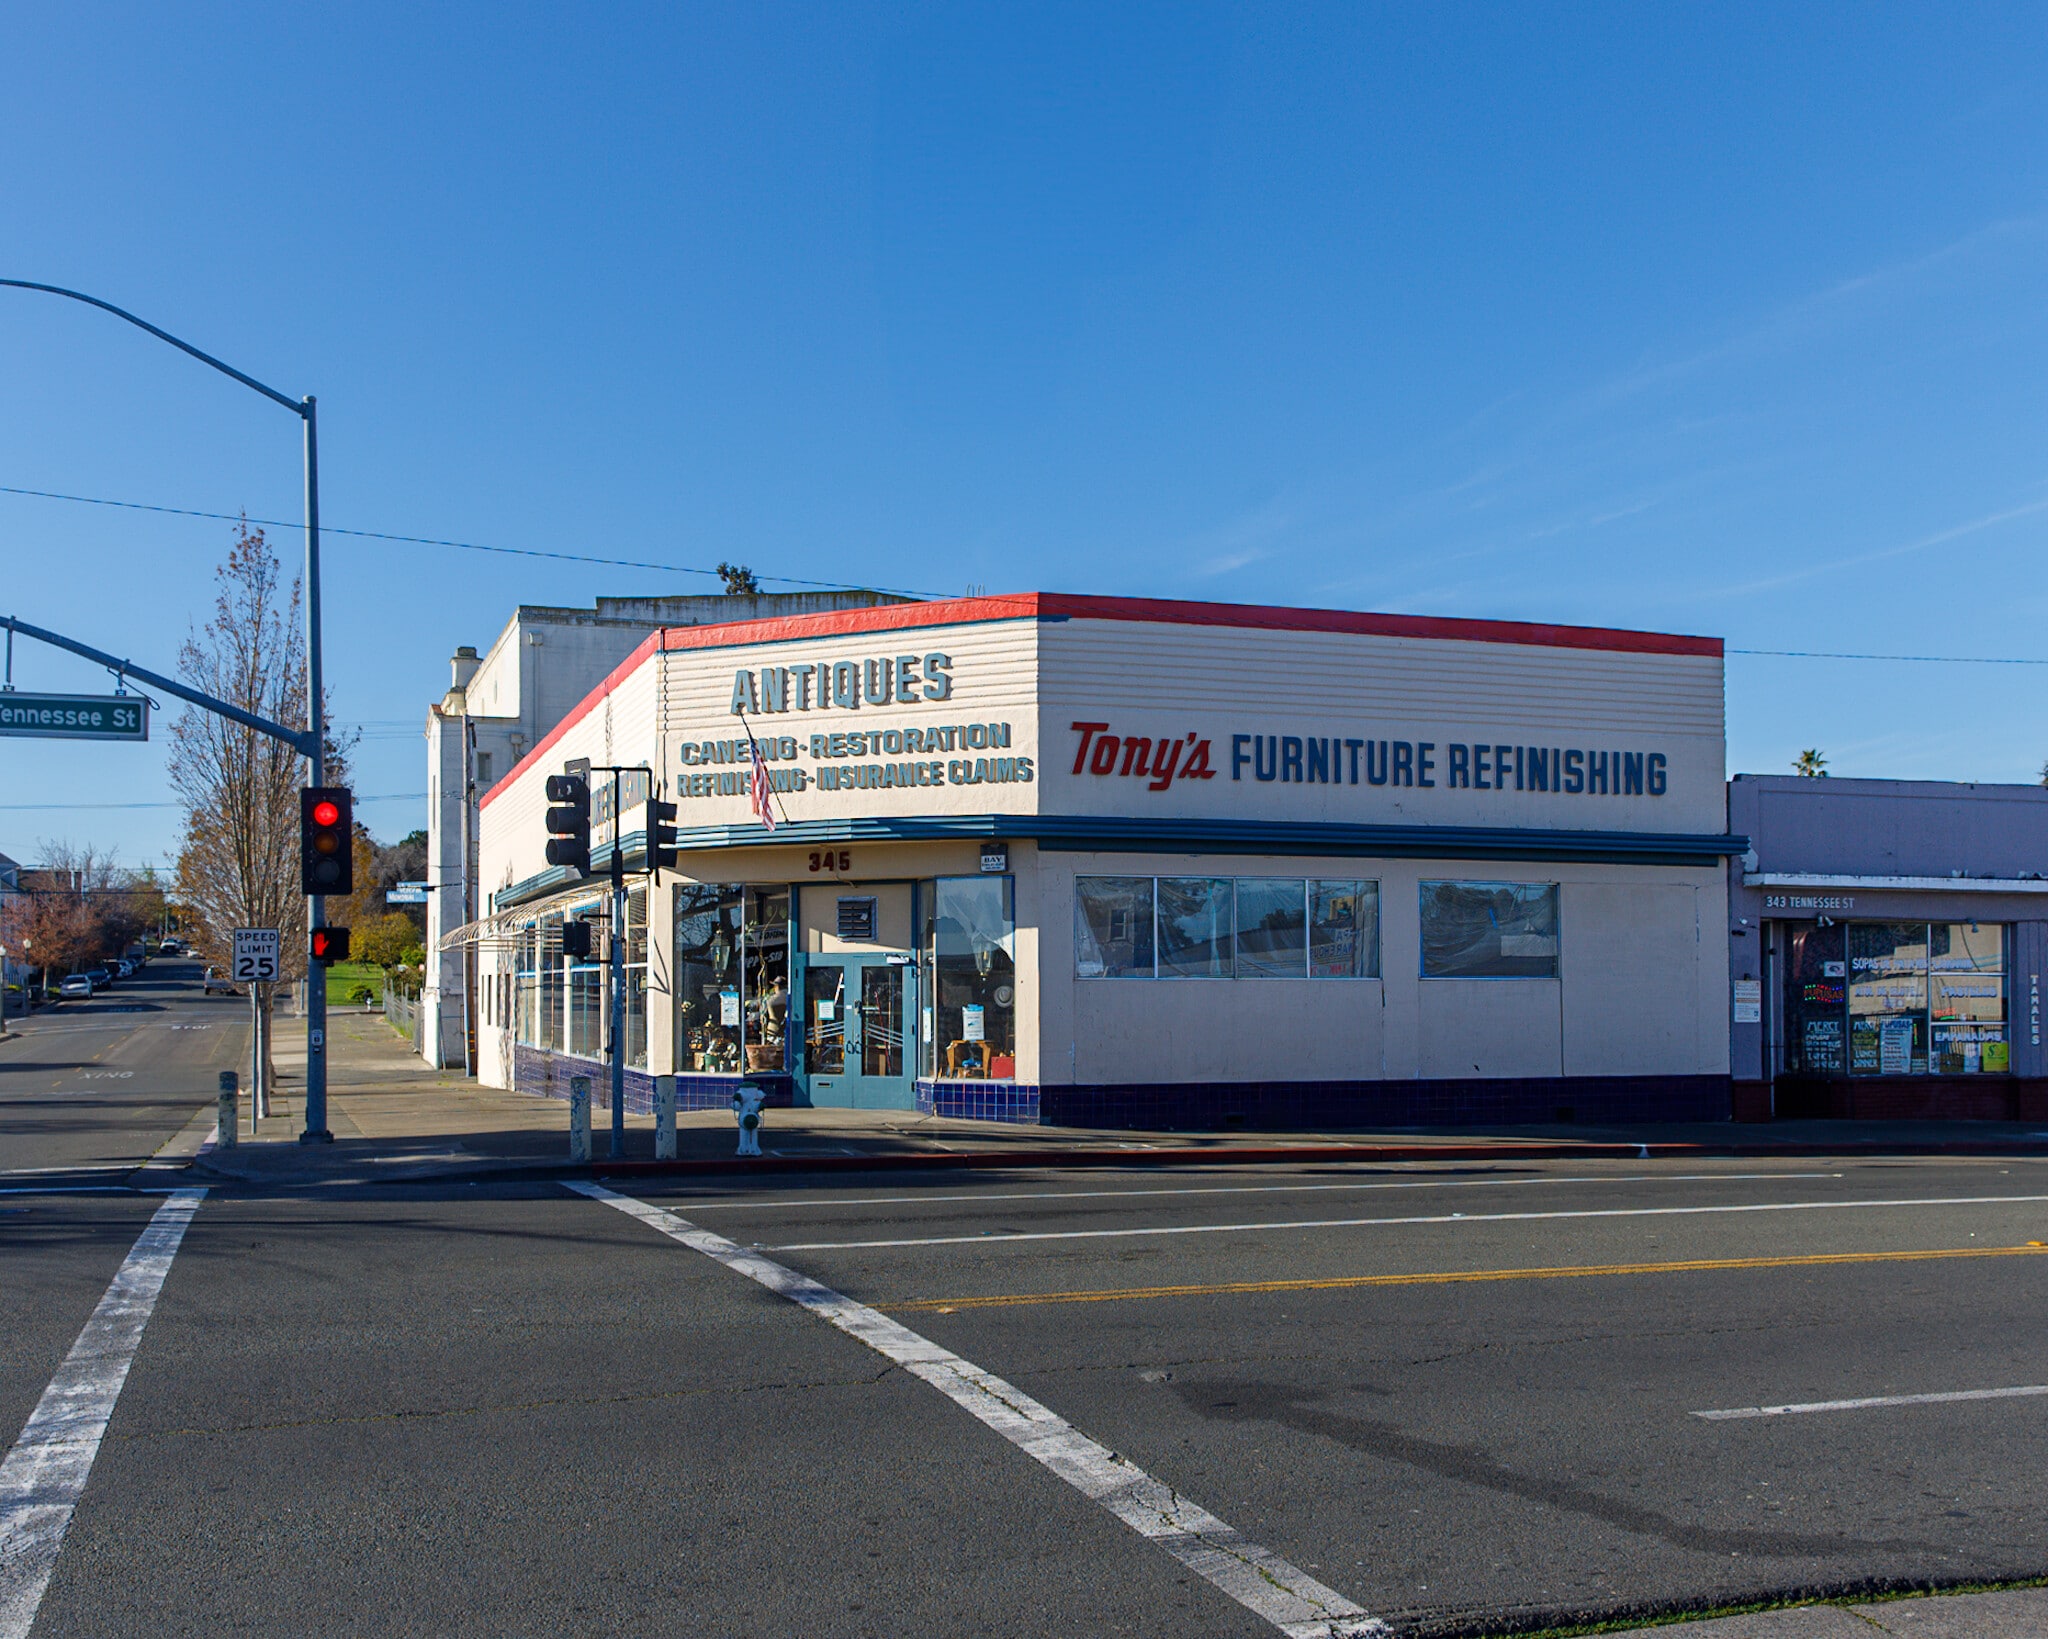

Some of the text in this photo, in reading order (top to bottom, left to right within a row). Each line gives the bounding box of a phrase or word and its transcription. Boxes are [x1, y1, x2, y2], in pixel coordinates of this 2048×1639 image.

[730, 652, 954, 716] ANTIQUES
[0, 703, 136, 727] ennessee St
[680, 721, 1012, 765] CANENG RESTORATION
[1071, 721, 1667, 795] Tony's FURNITURE REFINISHING
[677, 768, 807, 797] REFINISING
[816, 761, 946, 791] INSURANCE
[947, 756, 1035, 785] CLAIMS
[808, 851, 851, 872] 345
[1766, 895, 1856, 909] 343 TENNESSEE ST
[237, 932, 276, 941] SPEED
[240, 945, 272, 953] LIMIT
[239, 957, 274, 977] 25
[2029, 974, 2041, 1046] TAMALES
[1935, 1030, 2003, 1043] EMPANADAS
